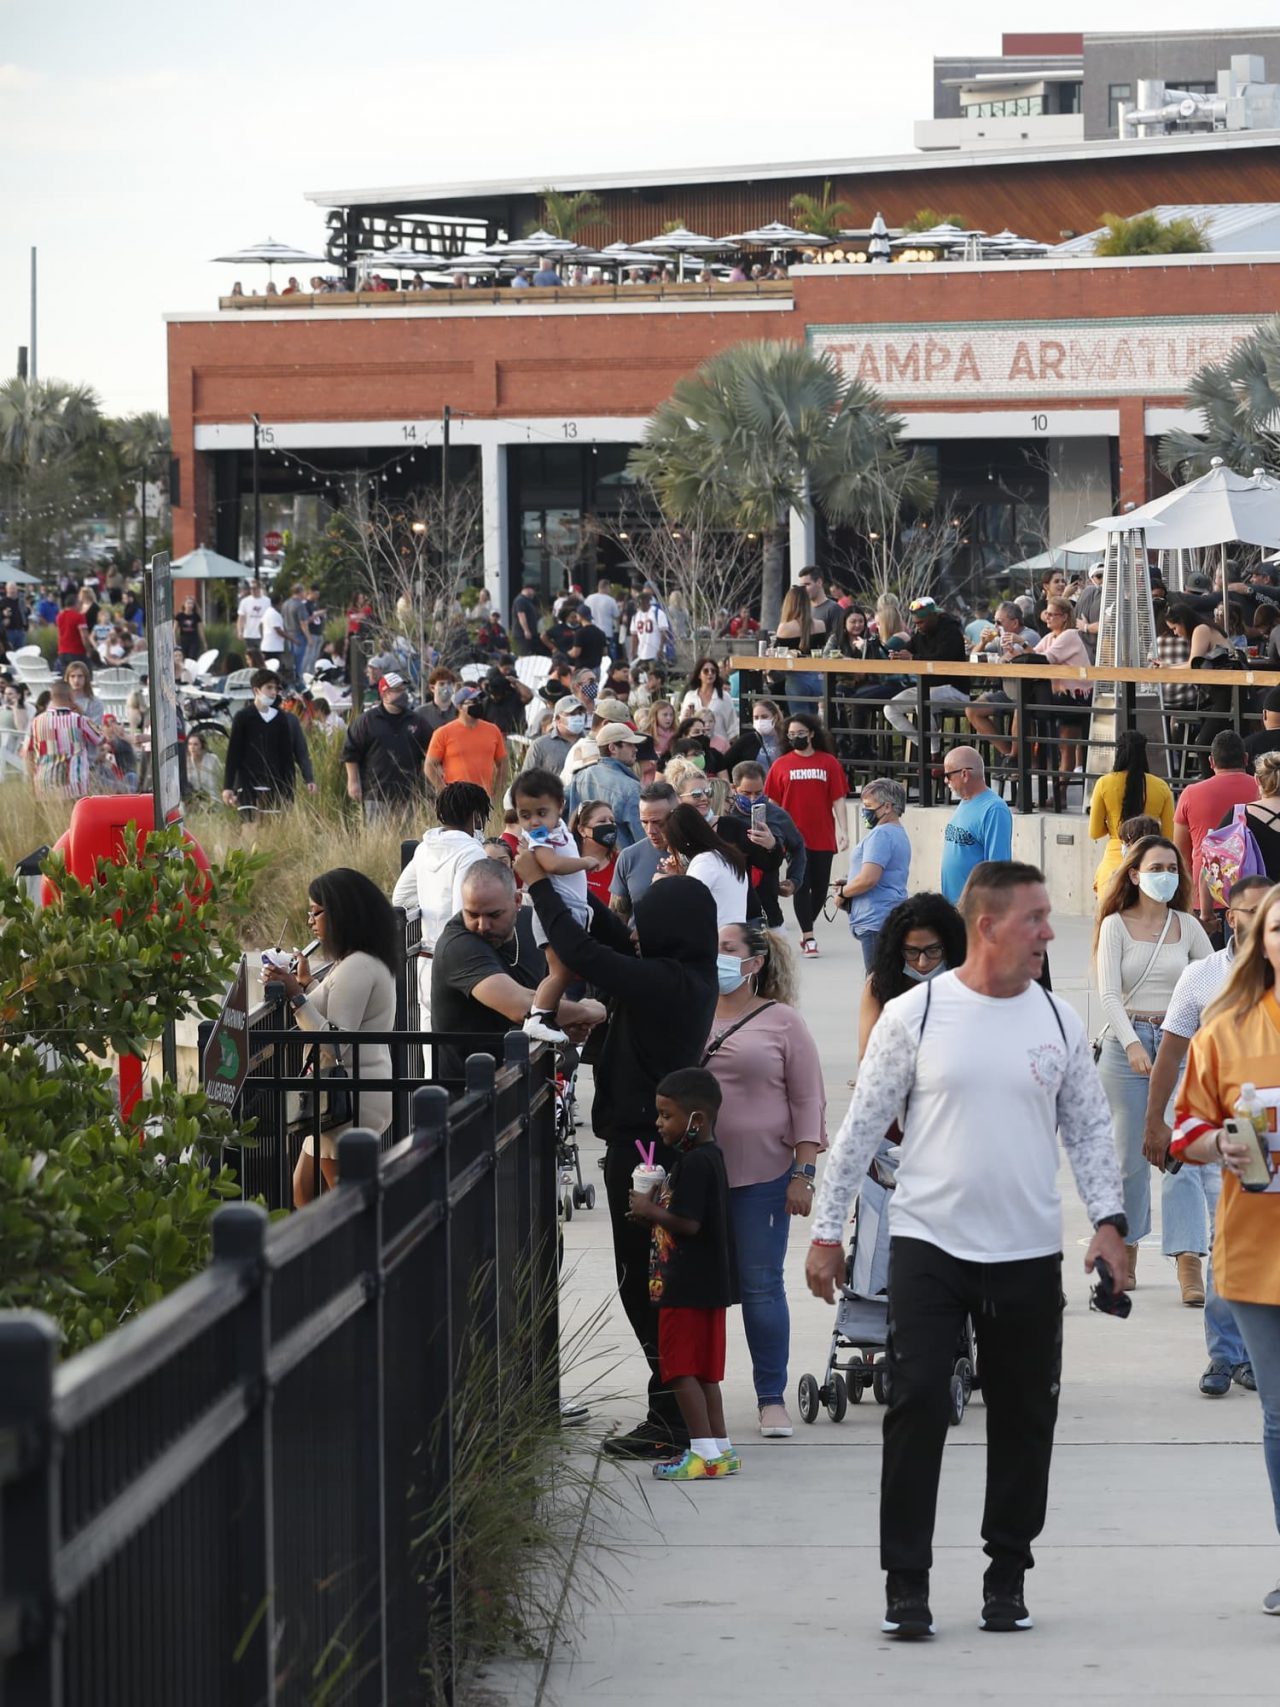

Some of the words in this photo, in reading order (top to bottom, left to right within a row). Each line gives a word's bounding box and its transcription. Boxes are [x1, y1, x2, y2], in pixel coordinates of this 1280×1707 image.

[823, 339, 981, 383] TAMPA
[1008, 336, 1247, 382] ARMATUR
[561, 422, 578, 438] 13
[1031, 414, 1048, 432] 10
[260, 427, 274, 443] 15
[402, 425, 416, 440] 14
[206, 1079, 237, 1105] ALLIGATORS
